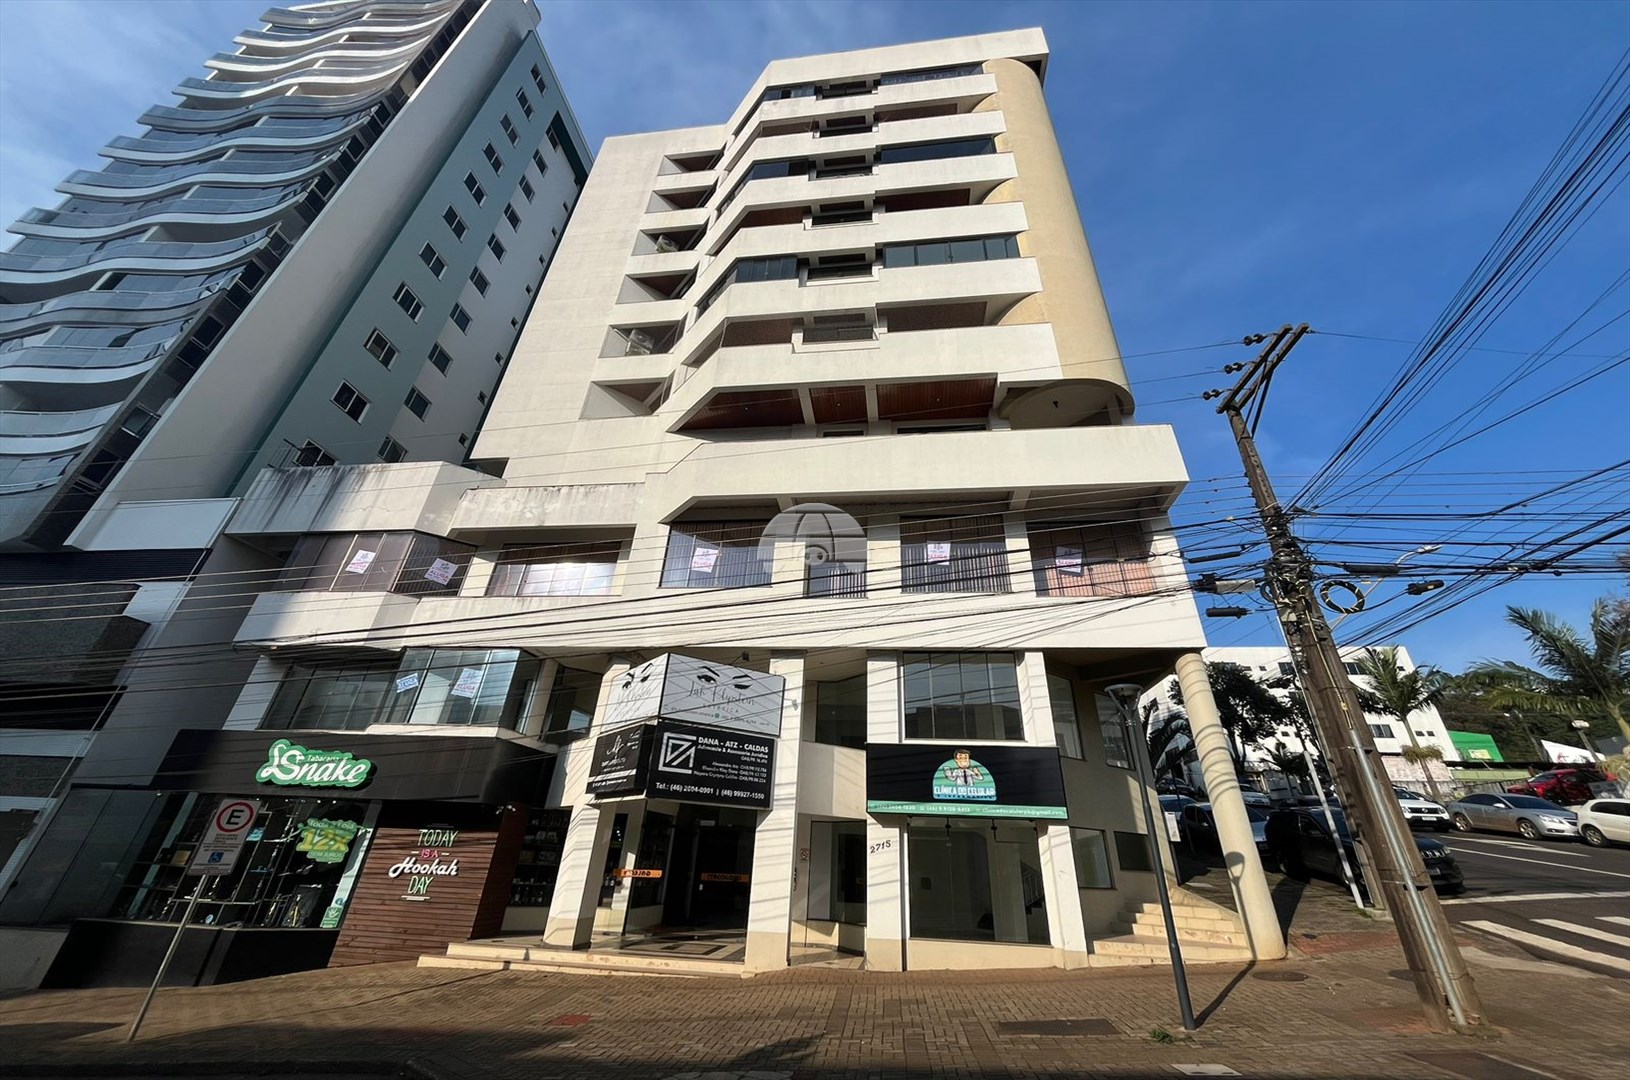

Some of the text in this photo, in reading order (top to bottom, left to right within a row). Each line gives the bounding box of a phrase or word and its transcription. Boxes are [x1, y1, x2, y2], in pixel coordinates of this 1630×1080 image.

[698, 737, 719, 746] DANA
[725, 741, 738, 749] ATZ
[744, 743, 769, 754] CALDAS
[670, 784, 683, 792] (46)
[226, 809, 245, 825] E
[418, 829, 458, 847] TODAY
[421, 849, 439, 858] IS A
[869, 839, 892, 854] 2715
[388, 856, 458, 878] Hookah
[408, 875, 433, 894] DAY
